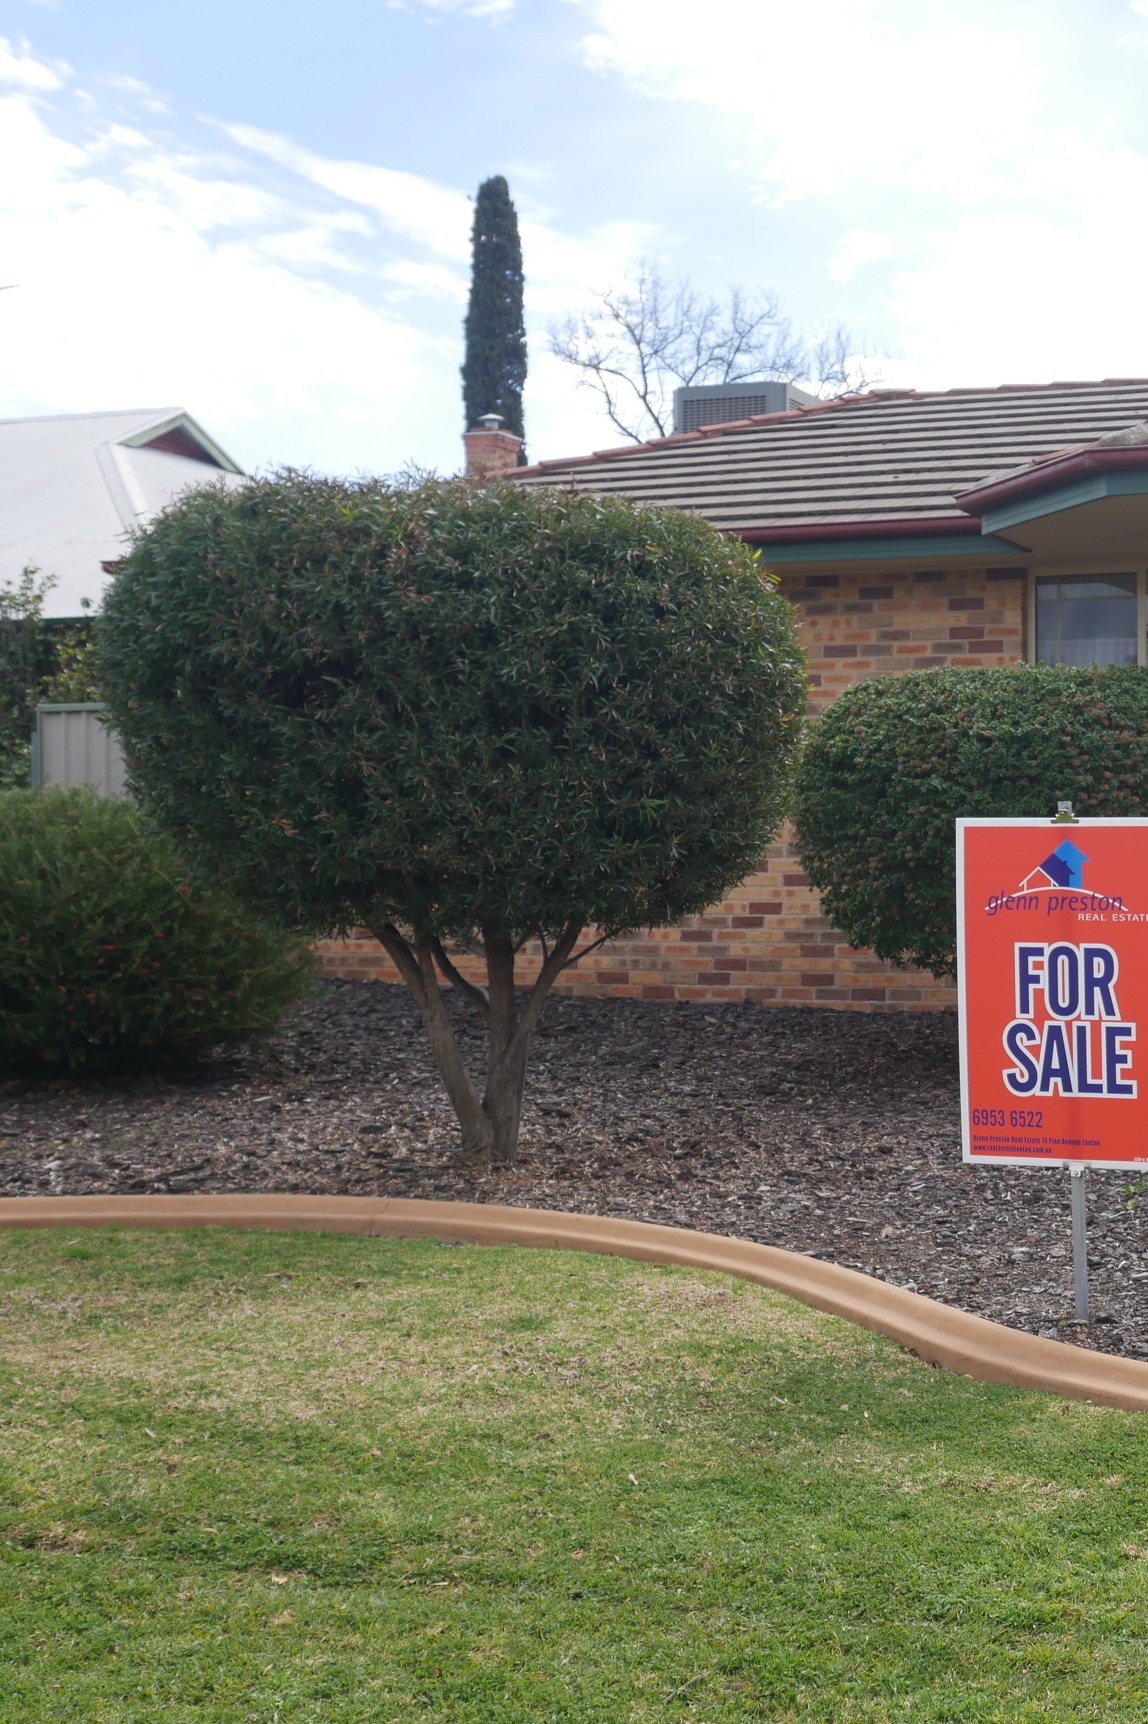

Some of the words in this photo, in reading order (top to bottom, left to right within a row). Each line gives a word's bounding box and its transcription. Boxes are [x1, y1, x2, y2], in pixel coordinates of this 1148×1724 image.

[987, 891, 1039, 916] glenn
[1047, 893, 1123, 916] preston
[1078, 913, 1106, 922] REAL
[1015, 942, 1121, 1020] FOR
[1003, 1020, 1137, 1098] SALE
[973, 1108, 1005, 1126] 6953
[1010, 1110, 1043, 1128] 6522
